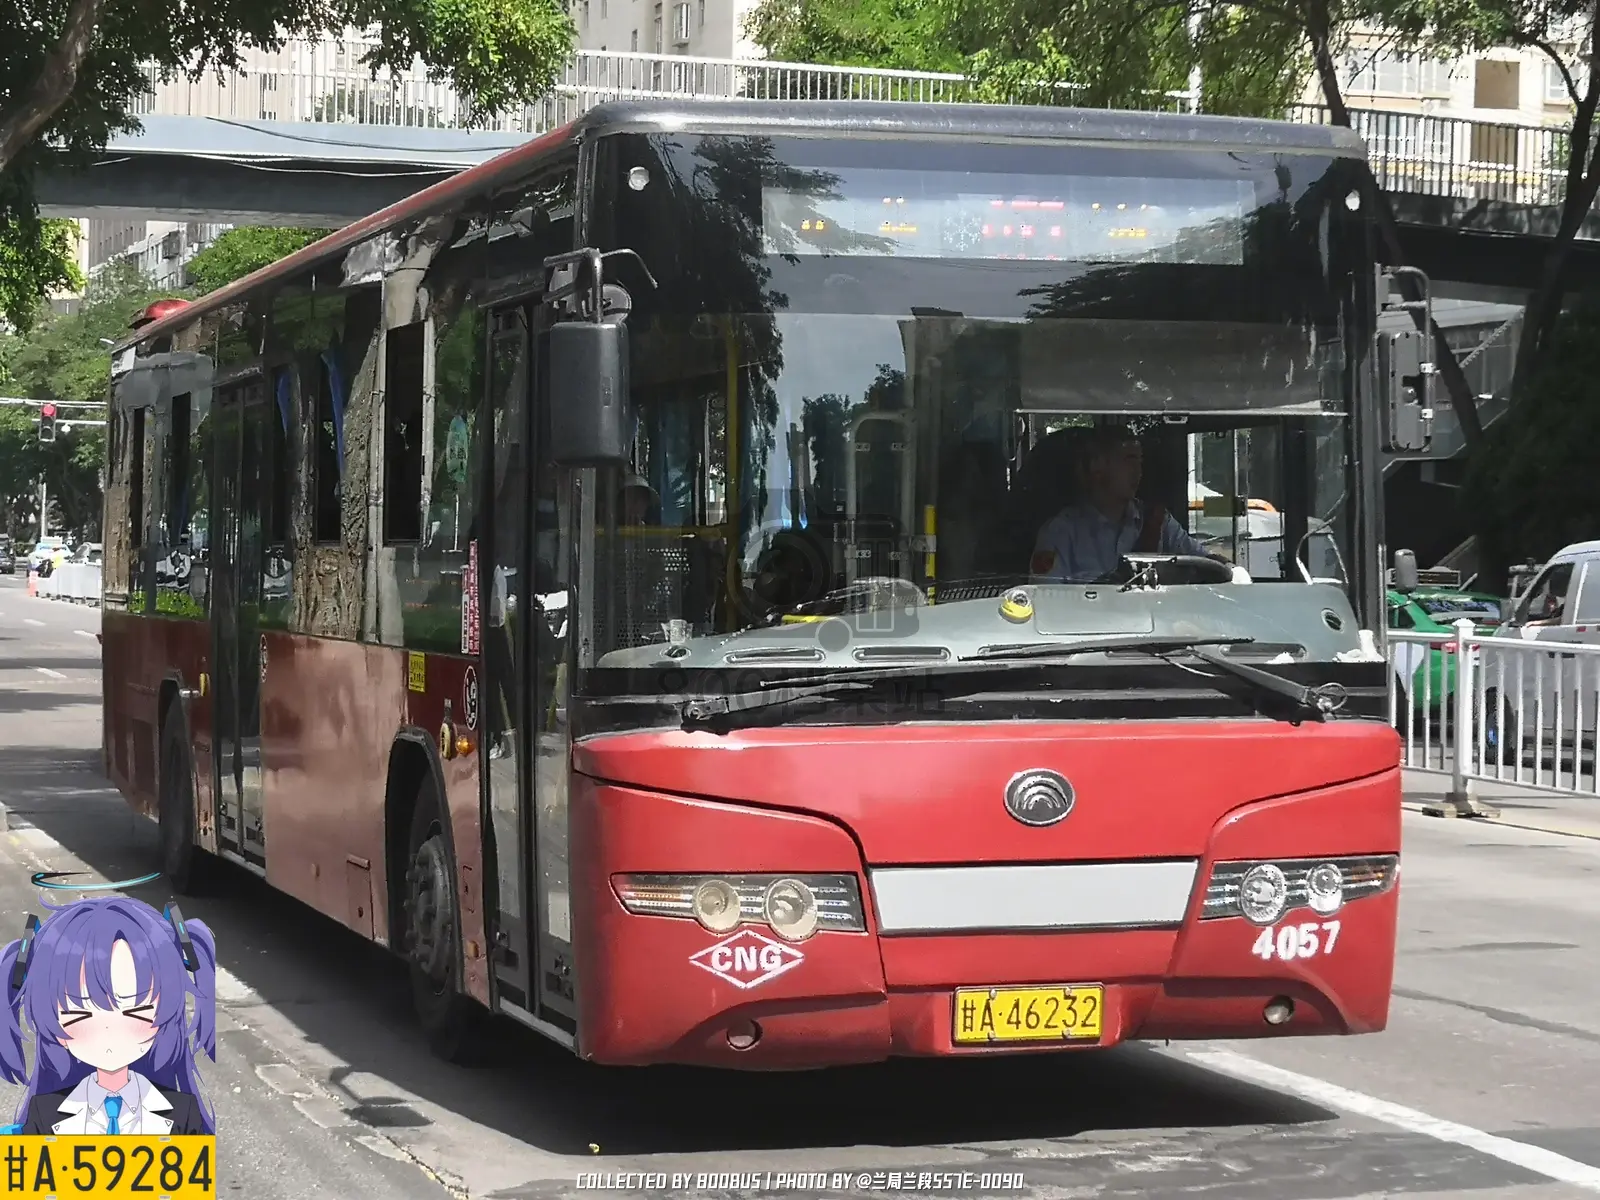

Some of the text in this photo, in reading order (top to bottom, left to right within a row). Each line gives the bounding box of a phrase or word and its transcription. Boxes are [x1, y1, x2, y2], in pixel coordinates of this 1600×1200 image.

[711, 944, 782, 972] CNG
[1252, 920, 1341, 960] 4057
[960, 994, 1097, 1033] 甘A·46232
